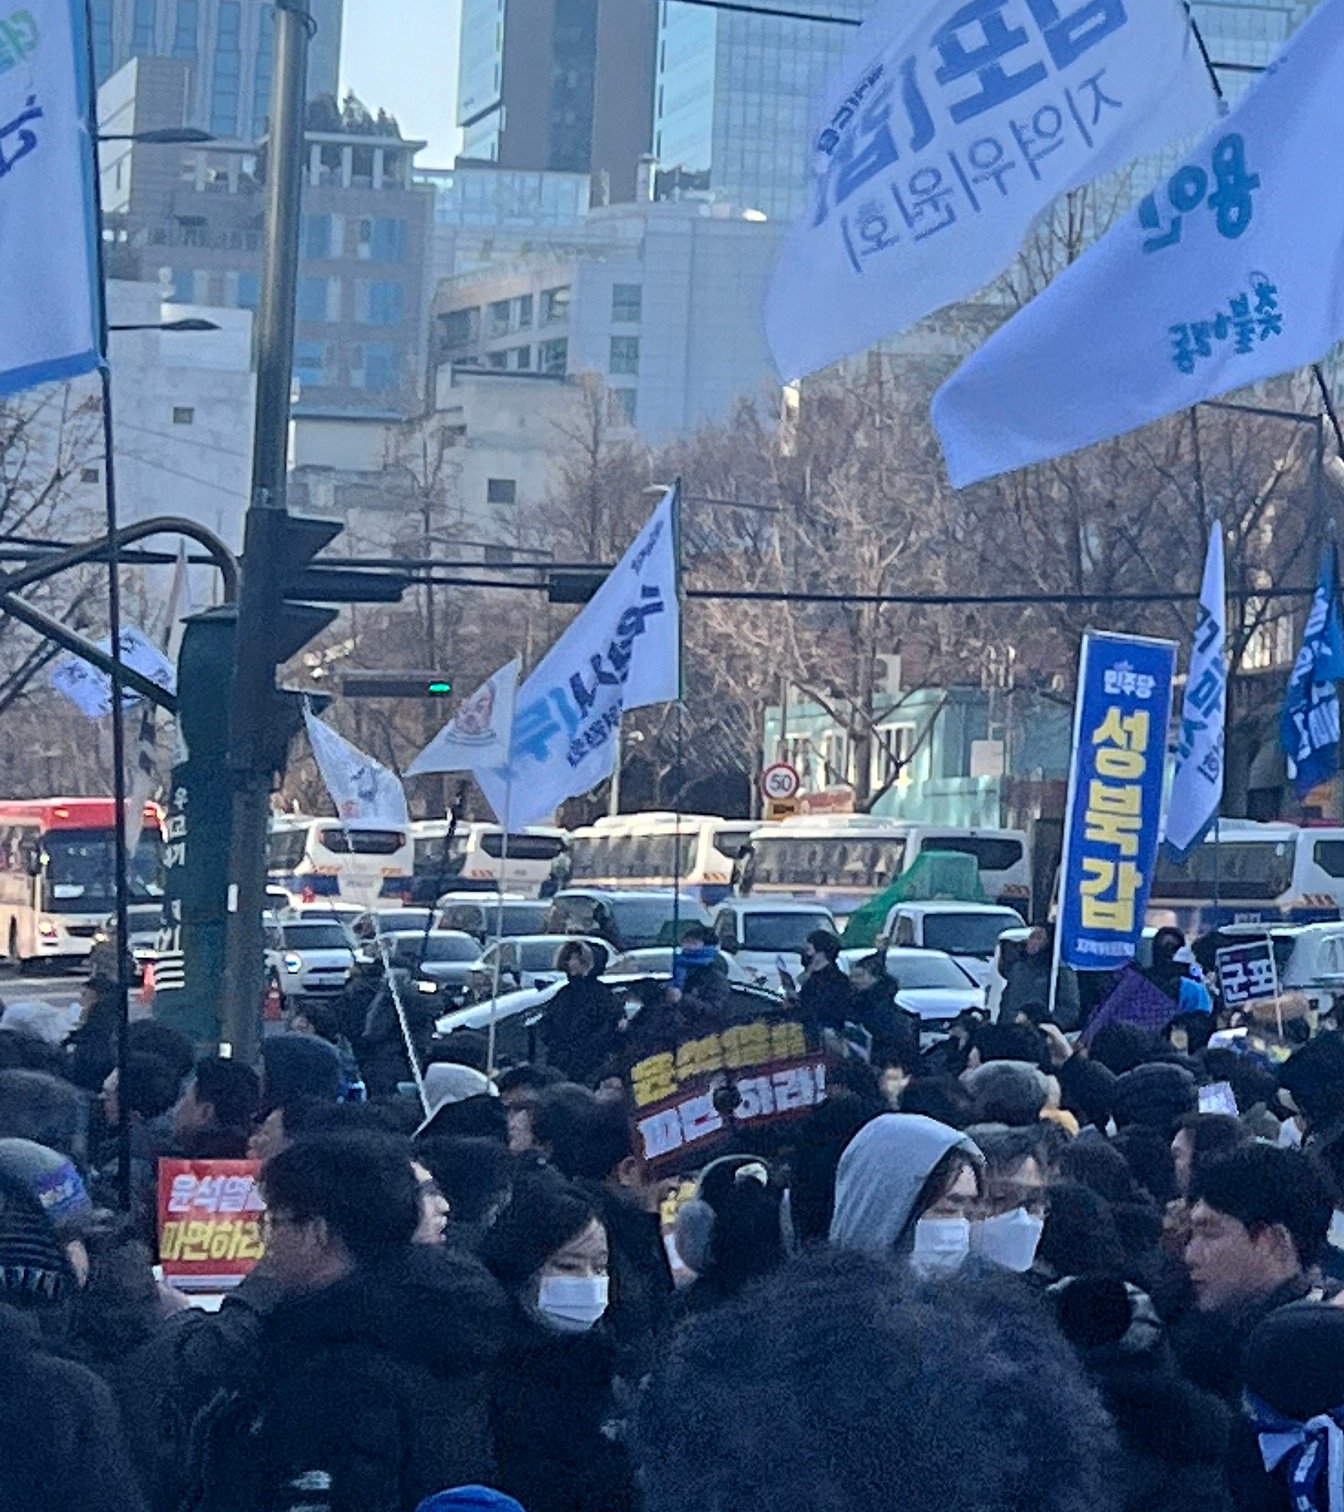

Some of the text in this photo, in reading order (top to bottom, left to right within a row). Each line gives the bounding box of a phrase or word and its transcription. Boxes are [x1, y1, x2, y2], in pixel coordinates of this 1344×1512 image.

[1102, 668, 1157, 700] 민주당
[769, 773, 793, 792] 50
[1079, 705, 1152, 934] 성북갑
